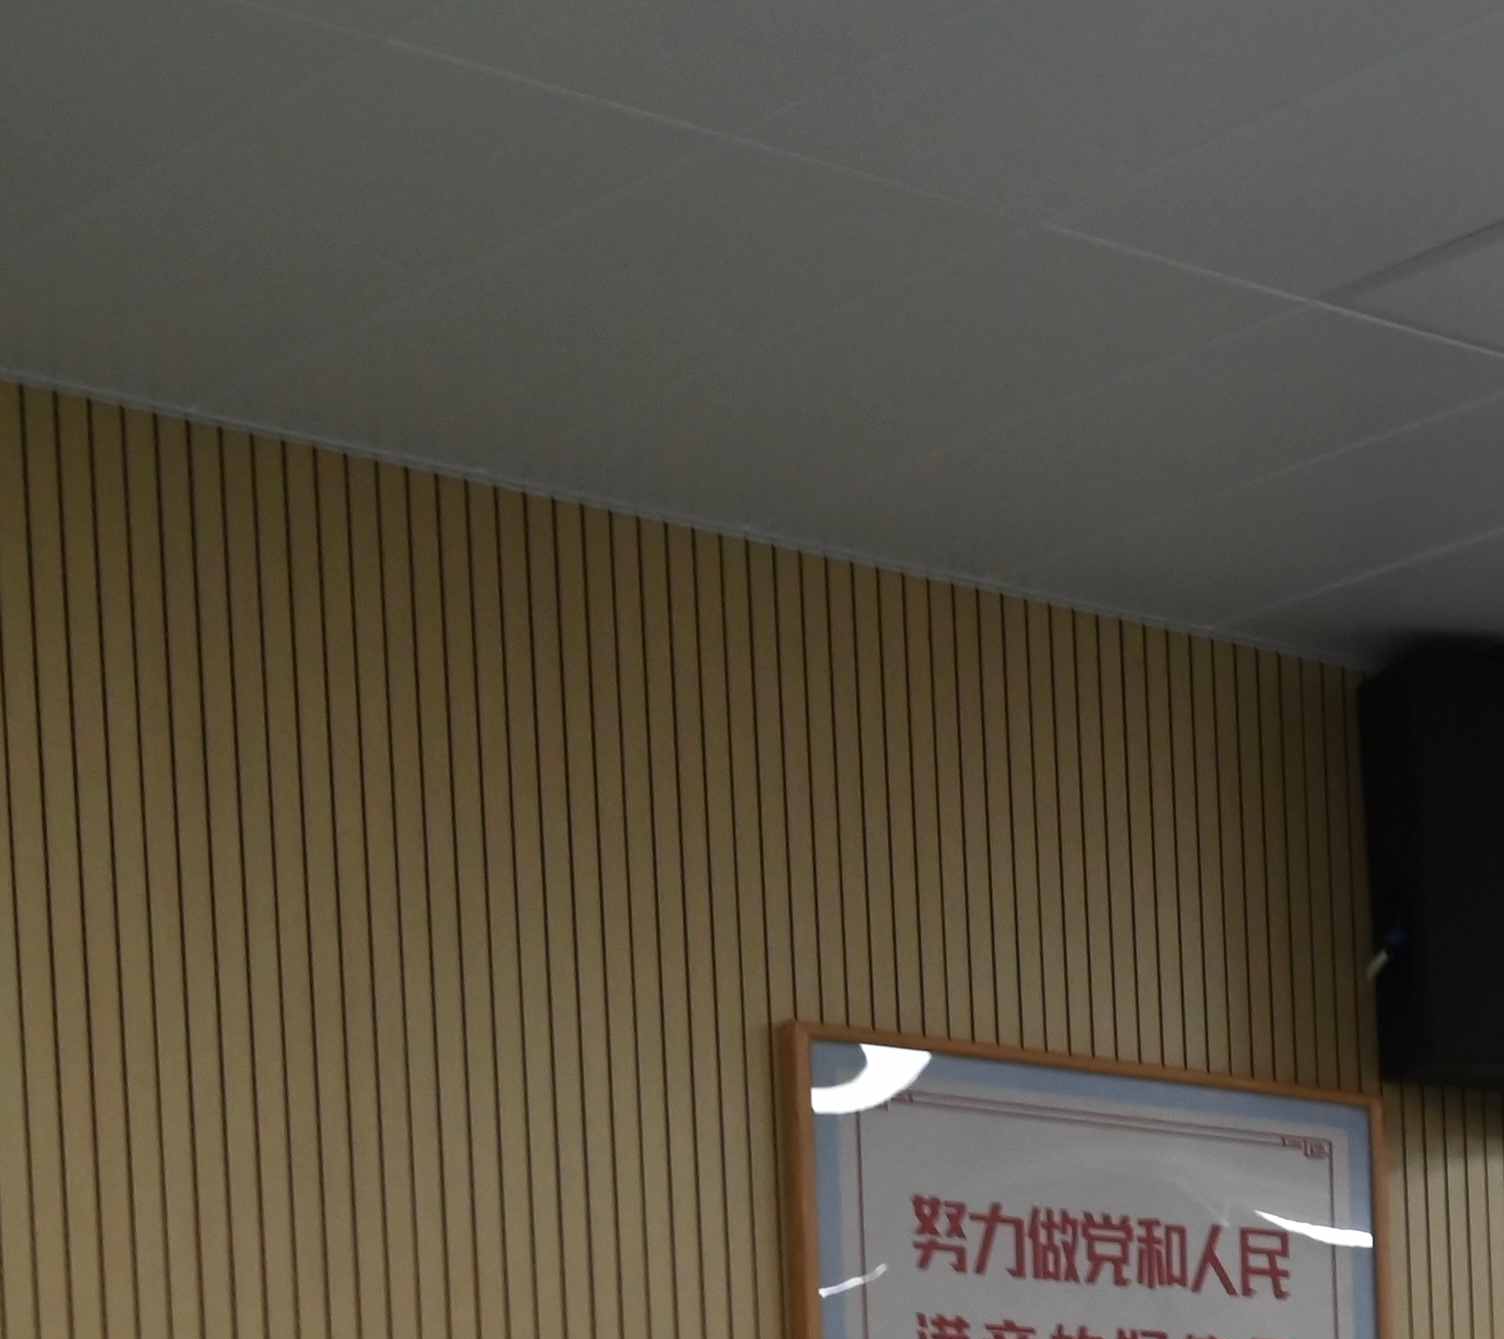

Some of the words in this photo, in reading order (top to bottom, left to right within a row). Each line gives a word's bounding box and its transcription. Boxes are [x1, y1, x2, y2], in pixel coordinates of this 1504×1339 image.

[912, 1195, 1291, 1300] 努力做党和人民
